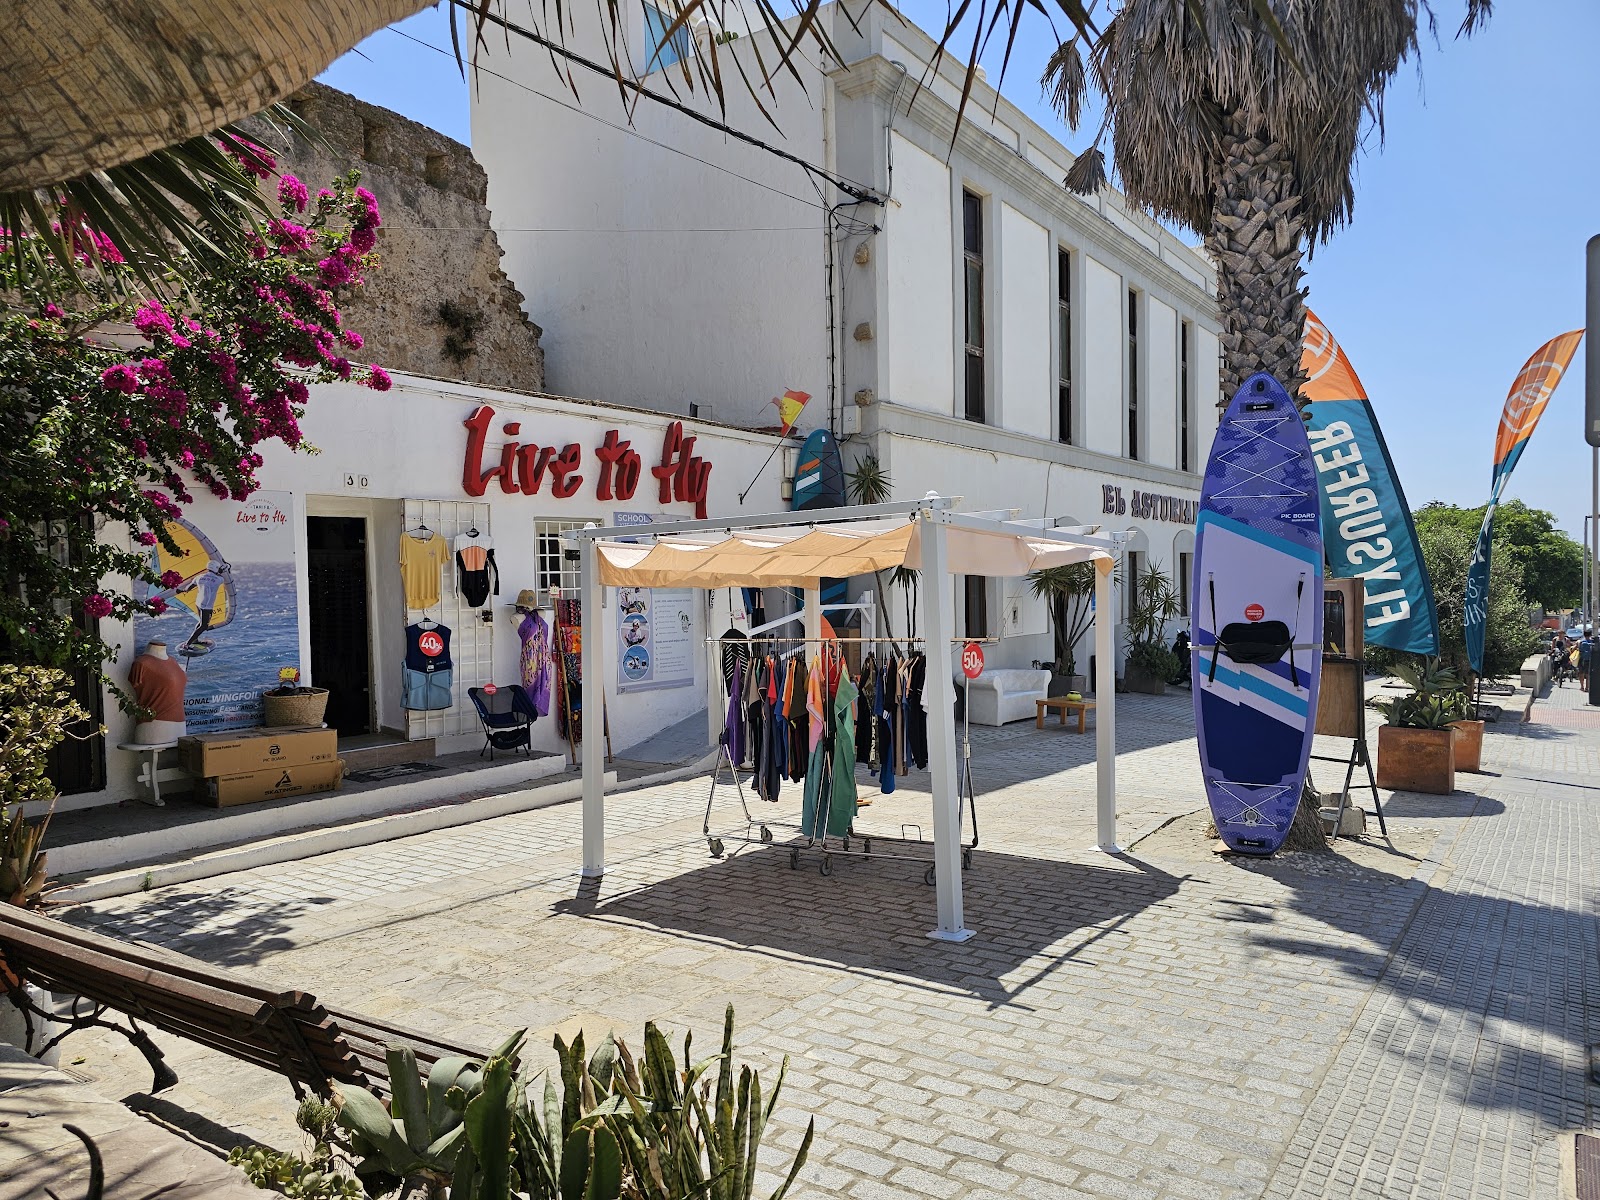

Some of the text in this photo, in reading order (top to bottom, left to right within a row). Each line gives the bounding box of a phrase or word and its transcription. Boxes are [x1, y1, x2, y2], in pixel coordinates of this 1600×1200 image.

[462, 406, 713, 519] Live to fly
[347, 475, 368, 487] 30
[237, 511, 256, 523] Live
[260, 512, 269, 523] to
[617, 514, 649, 523] SCHOOL
[421, 636, 443, 650] 40%
[963, 651, 983, 669] 50%
[212, 691, 260, 703] WINGFOIL
[264, 785, 303, 796] SKATINGER
